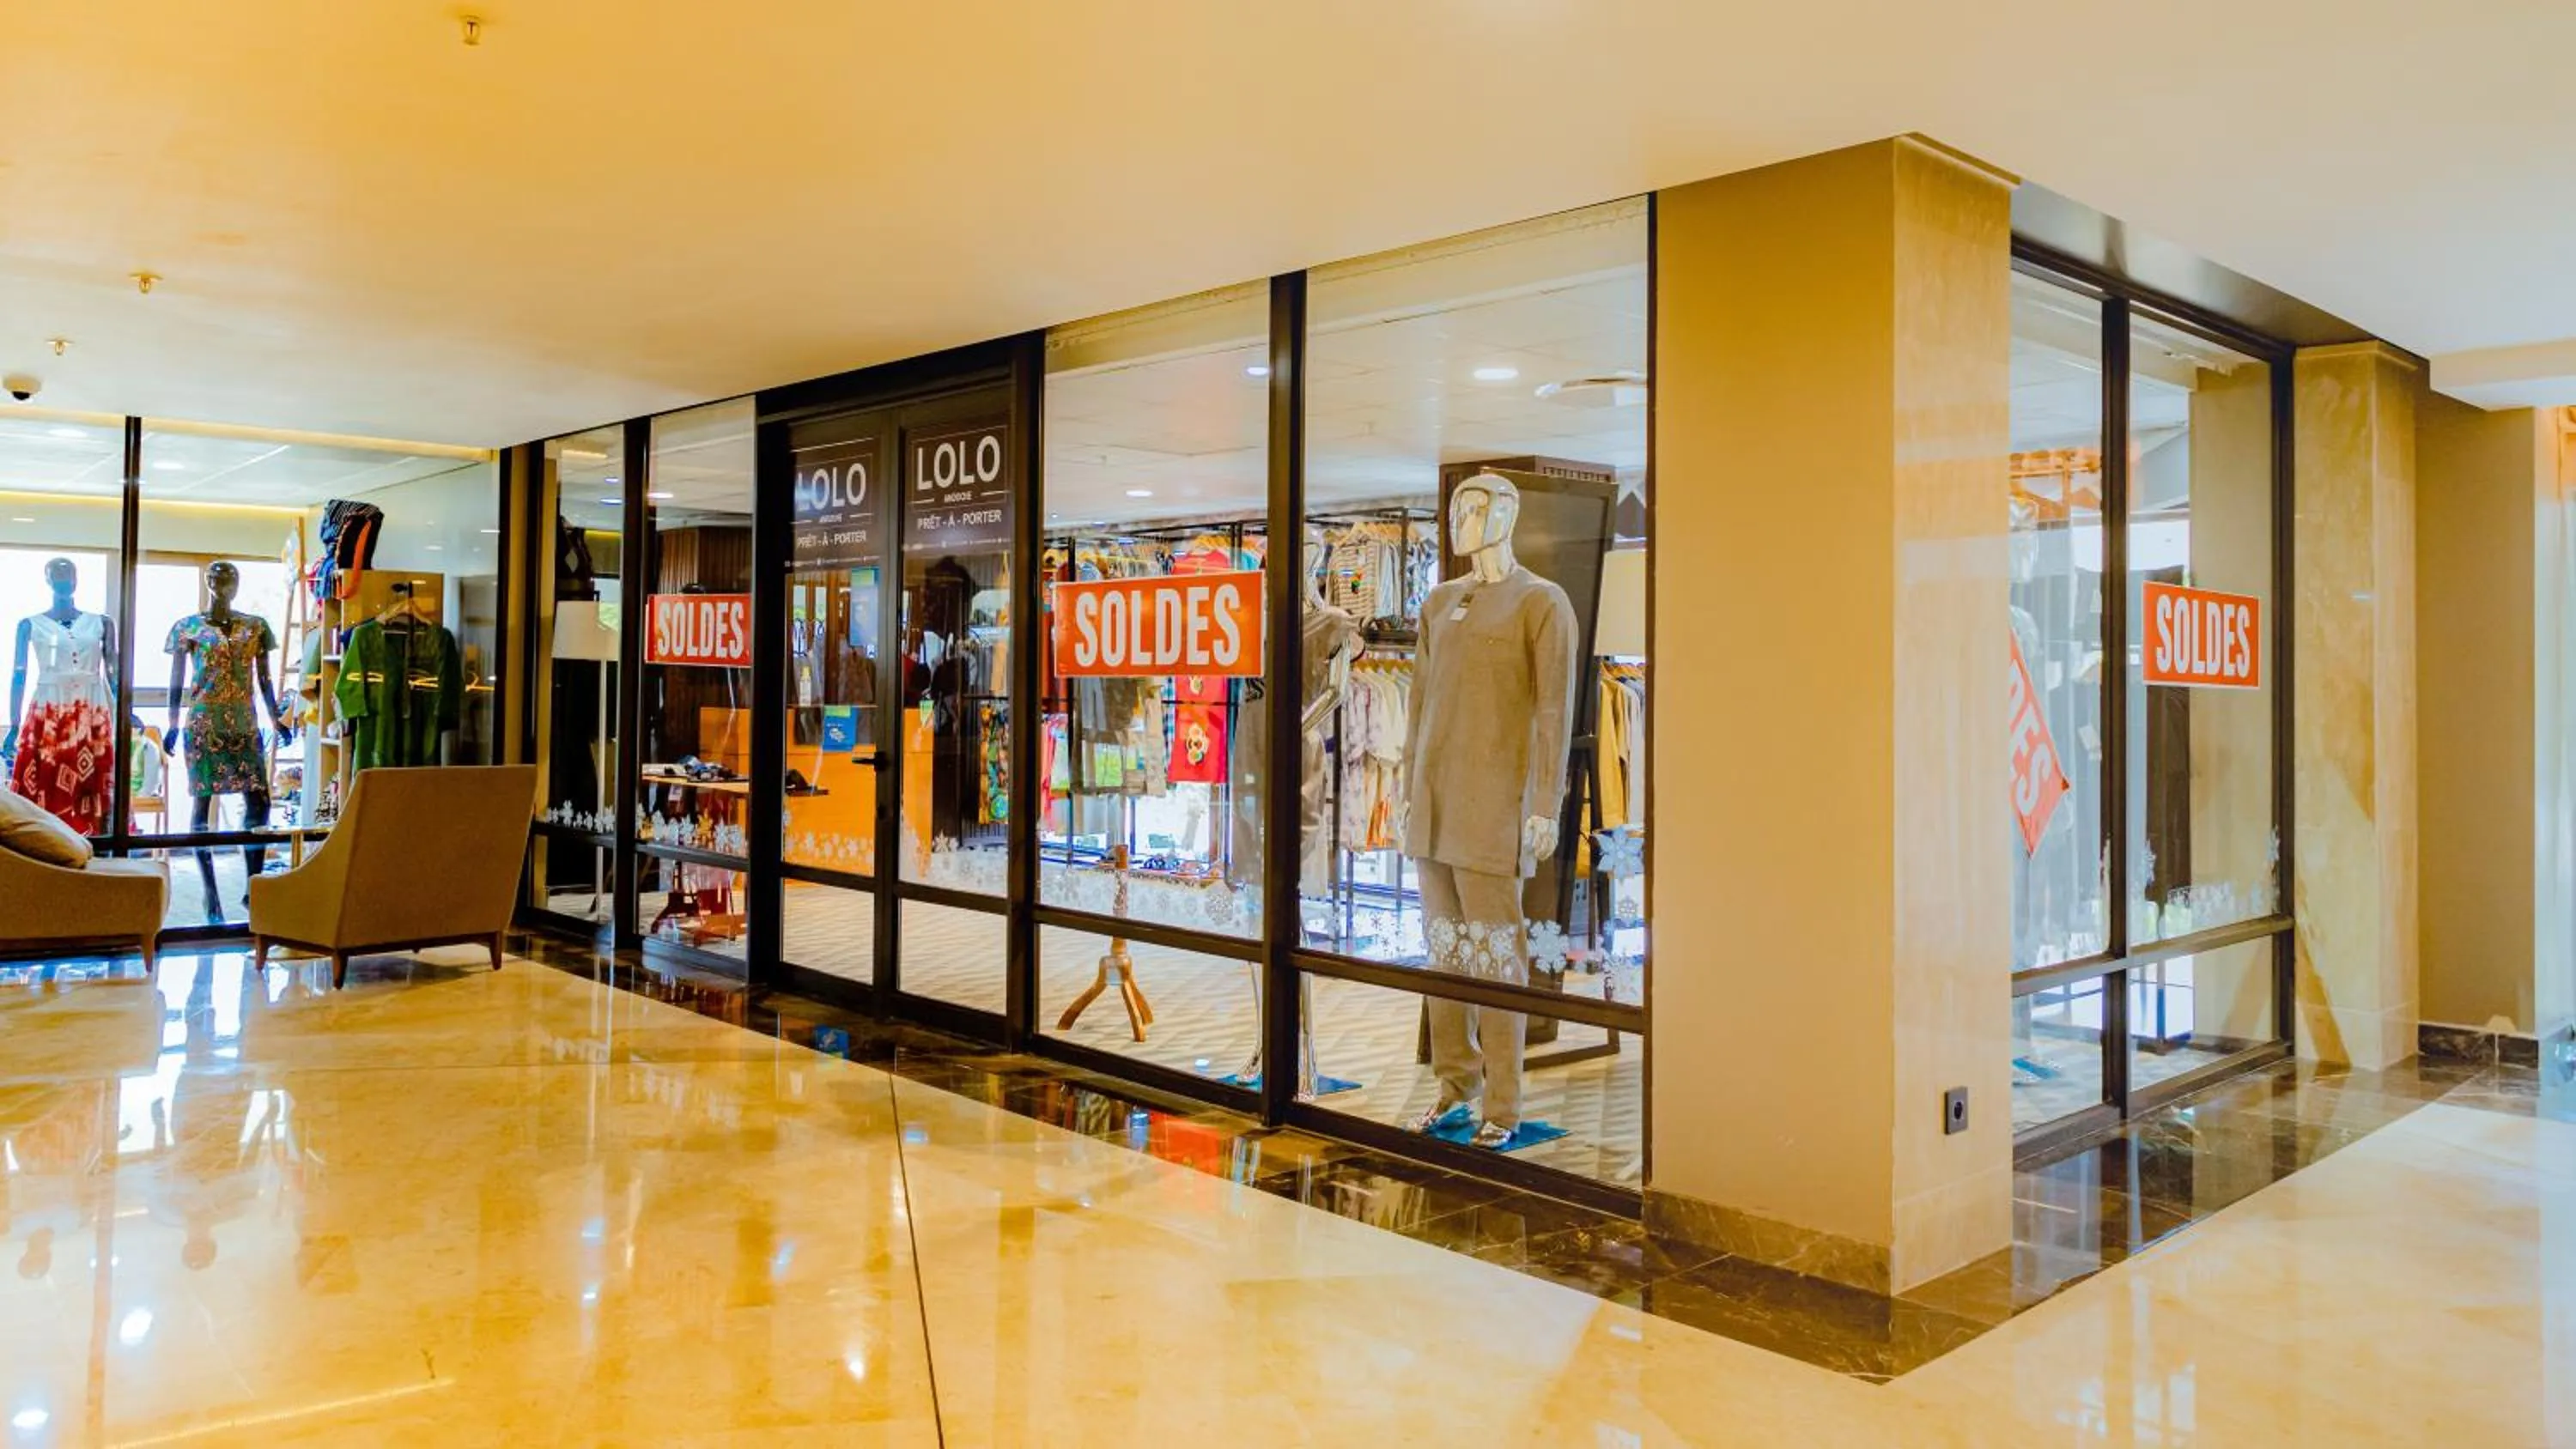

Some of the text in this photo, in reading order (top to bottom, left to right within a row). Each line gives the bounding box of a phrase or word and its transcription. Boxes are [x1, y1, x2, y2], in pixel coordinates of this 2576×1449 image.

[795, 463, 866, 512] LOLO
[916, 435, 1001, 491] LOLO
[963, 509, 1003, 525] PORTER
[658, 602, 744, 659] SOLDES
[1074, 584, 1241, 668] SOLDES
[2156, 594, 2251, 679] SOLDES
